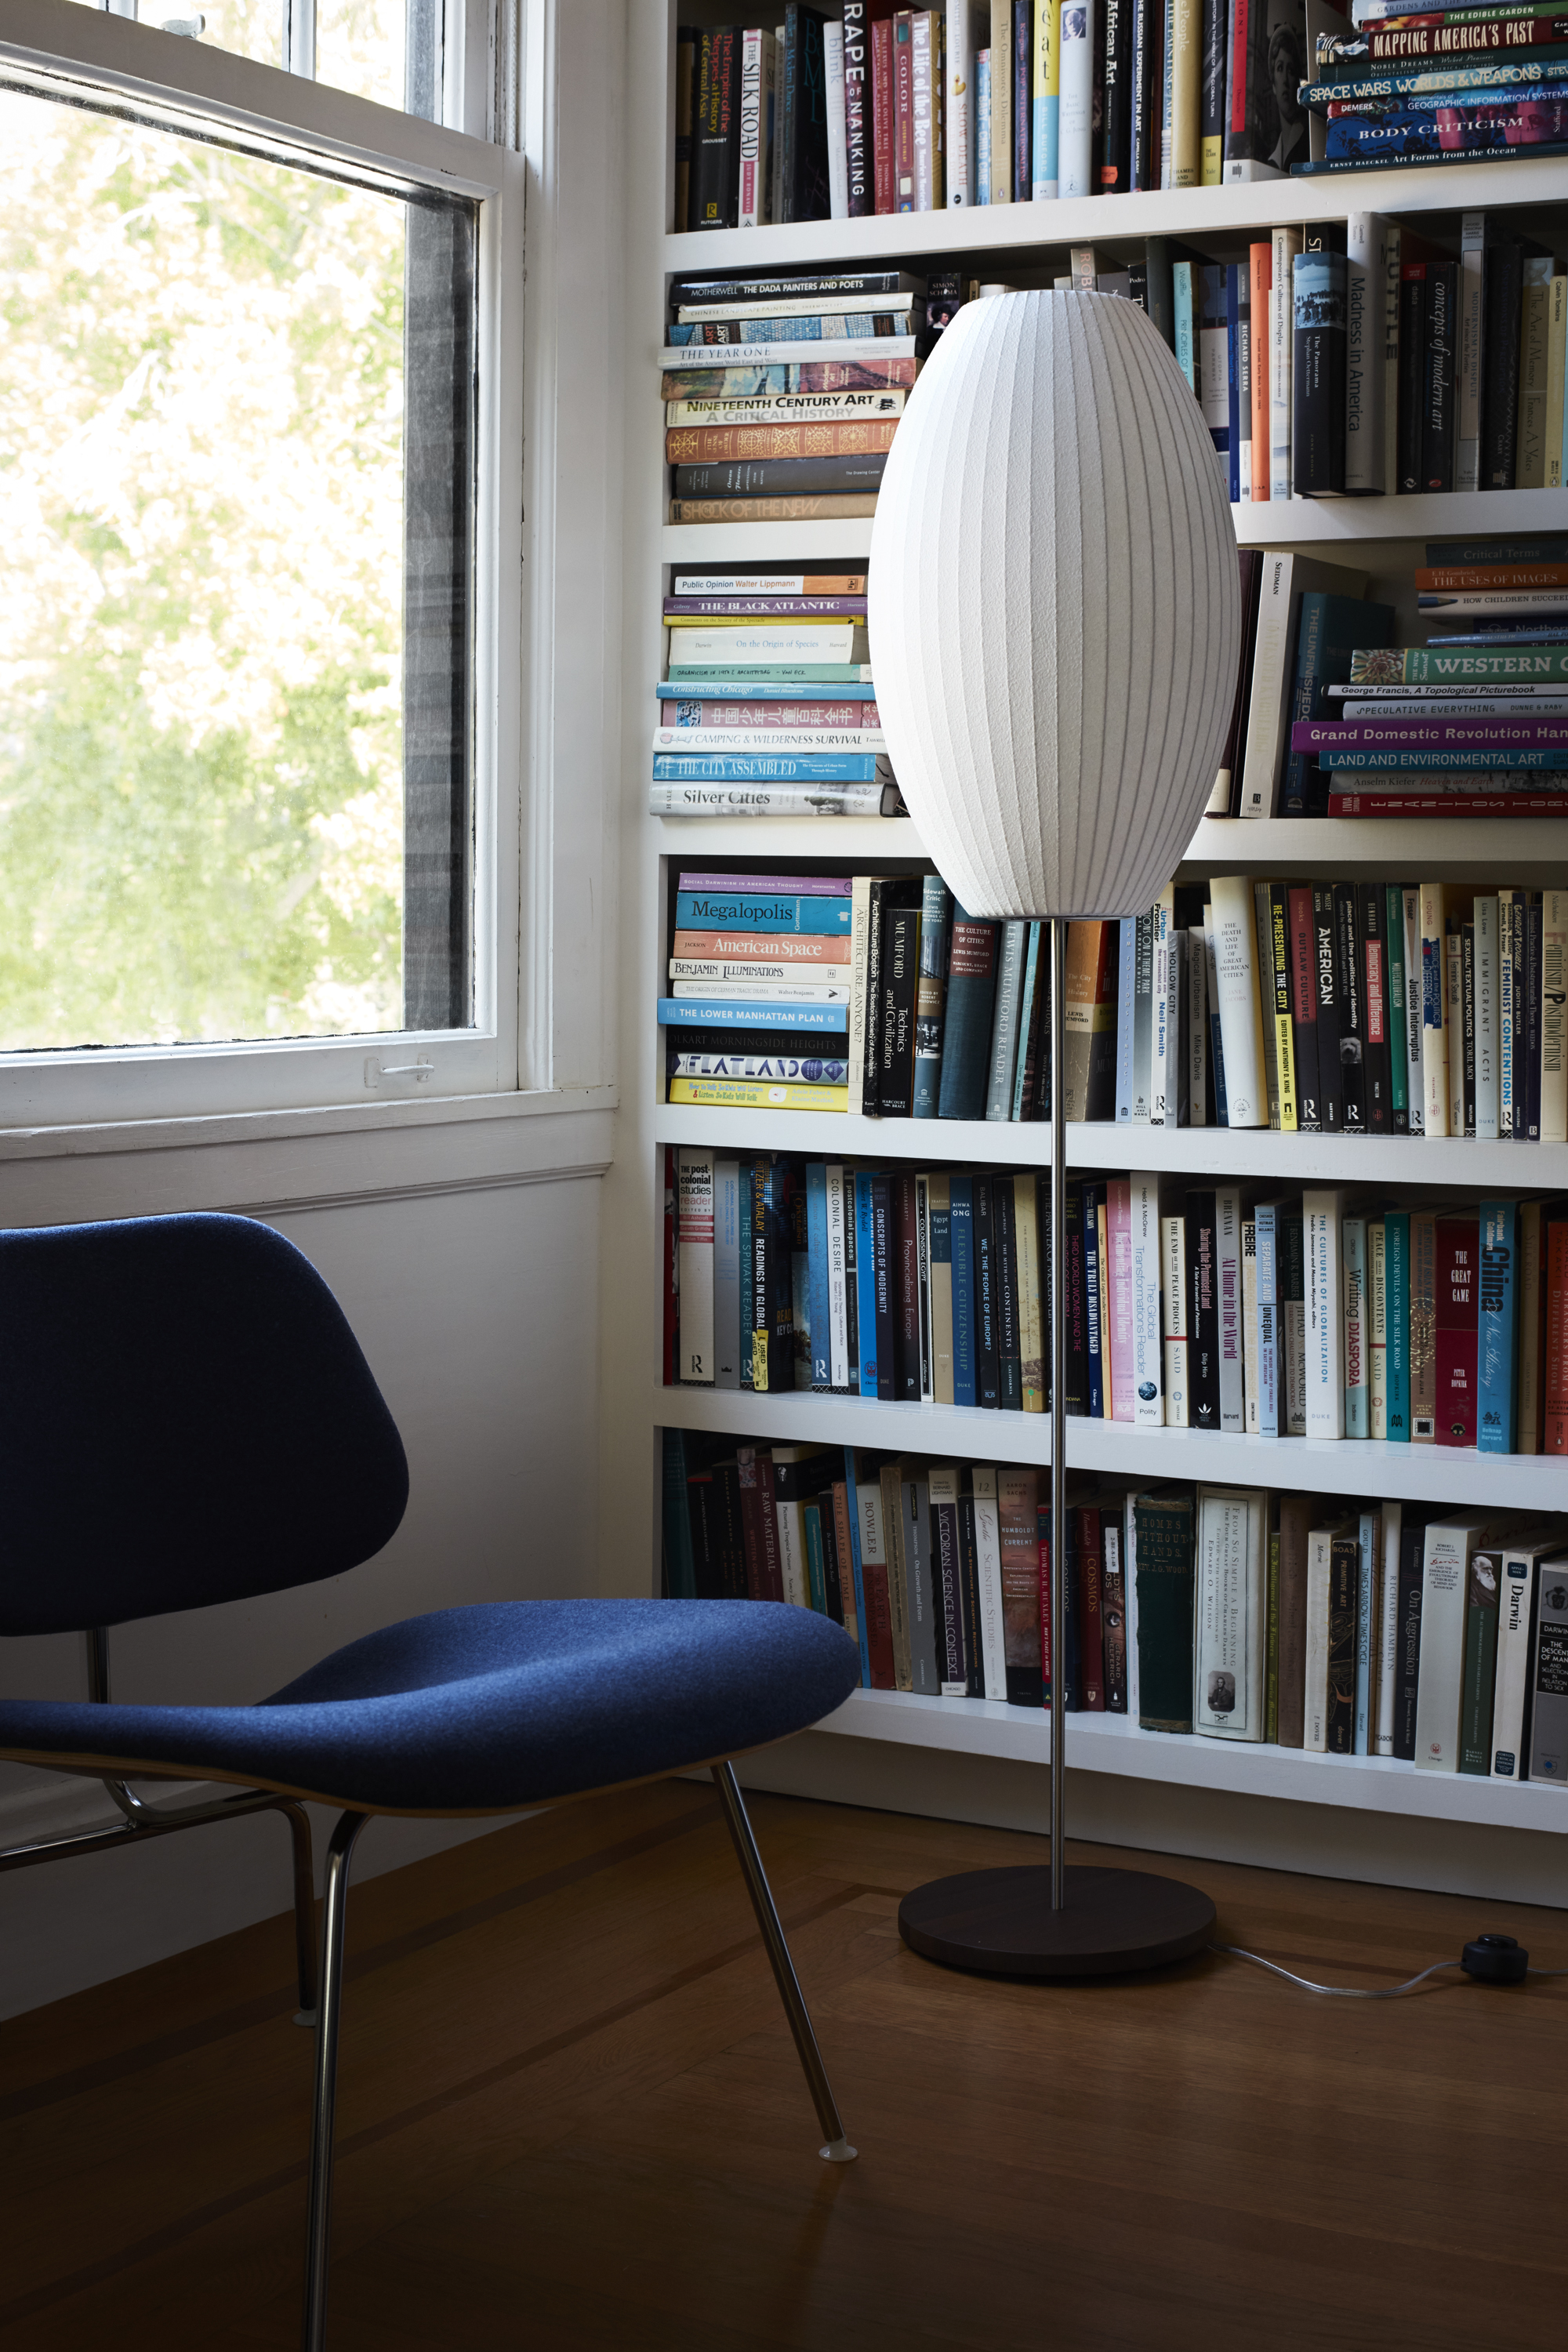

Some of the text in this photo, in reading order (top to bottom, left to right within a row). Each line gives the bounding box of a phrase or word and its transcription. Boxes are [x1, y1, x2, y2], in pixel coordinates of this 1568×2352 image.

[1468, 10, 1496, 19] EDIBLE
[1499, 6, 1534, 16] GARDEN
[1106, 0, 1118, 85] African Art
[1374, 21, 1534, 57] MAPPING AMERICA'S PAST
[1309, 66, 1541, 102] SPACE WARS WORLDS & WEAPONS
[742, 42, 760, 158] THE SILK ROAD
[844, 2, 865, 195] RAPE OF NANKING
[1359, 118, 1523, 140] BODY CRITICISM
[1392, 154, 1407, 163] Art
[1411, 153, 1439, 162] Forms
[1443, 151, 1465, 159] from
[691, 287, 738, 296] MOTHERWELL
[759, 285, 781, 293] DADA
[782, 282, 816, 292] PAINTERS
[818, 281, 837, 290] AND
[839, 280, 863, 289] POETS
[680, 347, 771, 359] THE YEAR ONE
[1348, 278, 1366, 432] Madness in America
[1429, 281, 1451, 430] concepts of modern art
[844, 394, 874, 405] ART
[1273, 562, 1283, 595] SEIDMAN
[1435, 657, 1552, 673] WESTERN
[711, 706, 853, 725] 中国少年儿童百科全书
[753, 735, 813, 744] WILDERNESS
[815, 735, 862, 744] SURVIVAL
[1311, 729, 1357, 740] Grand
[1363, 728, 1439, 739] Domestic
[1445, 728, 1530, 739] Revolution
[677, 761, 796, 775] THE CITY ASSEMBLED
[1330, 754, 1544, 765] LAND AND ENVIRONMENTAL ART
[684, 790, 770, 804] Silver Cities
[692, 901, 793, 921] Megalopolis
[713, 938, 779, 955] American
[782, 942, 822, 957] Space
[894, 920, 905, 978] MUMFORD
[1273, 905, 1287, 1009] RE-PRESENTING THE CITY
[675, 963, 783, 979] BENJAMIN ILLUMINATIONS
[1319, 927, 1334, 1005] AMERICAN
[1368, 944, 1383, 1036] Democracy and Difference
[680, 1009, 823, 1022] THE LOWER MANHATTAN PLAN
[1409, 979, 1419, 1062] Justice Interruptus
[884, 1004, 895, 1069] Civilization
[897, 1008, 908, 1052] Technics
[1502, 959, 1512, 1105] FEMINIST CONTENTIONS
[681, 1175, 710, 1185] colonial
[691, 1165, 711, 1175] post-
[681, 1185, 711, 1195] studies
[681, 1196, 711, 1205] reader
[831, 1178, 840, 1229] COLONIAL
[877, 1209, 887, 1313] CONSCRIPTS OF MODERNITY
[1456, 1251, 1467, 1264] THE
[756, 1239, 765, 1330] READINGS IN GLOBAL
[1451, 1270, 1471, 1283] GREAT
[1321, 1288, 1327, 1301] OF
[1452, 1289, 1469, 1302] GAME
[1262, 1307, 1272, 1344] UNEQUAL
[1346, 1269, 1361, 1387] Writing DIASPORA
[865, 1502, 877, 1555] BOWLER
[1142, 1518, 1181, 1529] HOMES
[1138, 1533, 1188, 1543] WITHOUT
[940, 1511, 957, 1675] VICTORIAN SCIENCE IN CONTEXT
[1087, 1559, 1098, 1612] COSMOS
[1410, 1590, 1421, 1609] On
[1509, 1584, 1523, 1631] Darwin
[1406, 1613, 1420, 1675] Aggression
